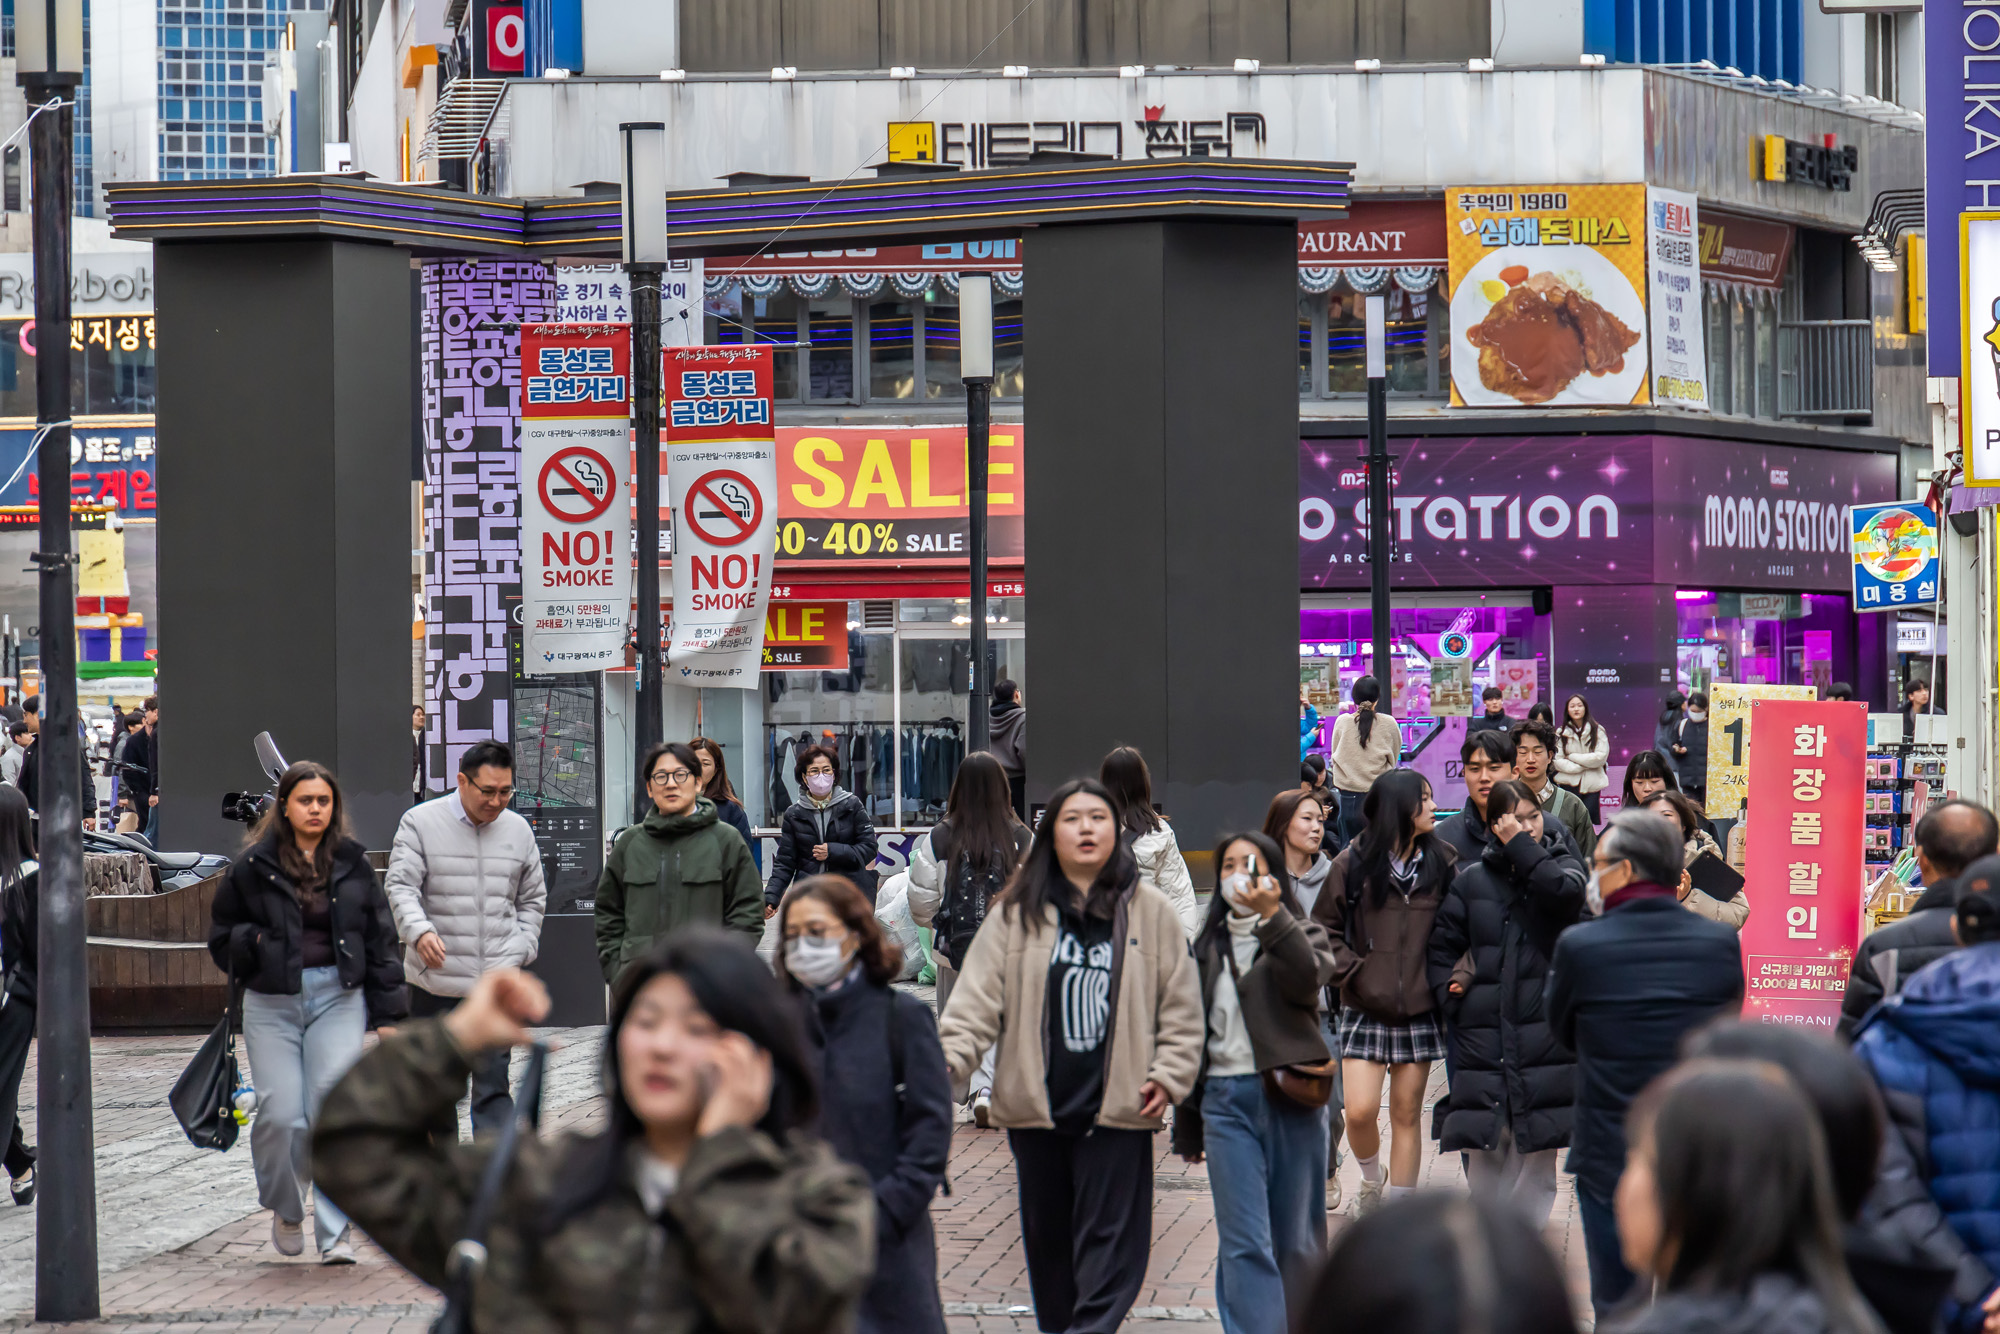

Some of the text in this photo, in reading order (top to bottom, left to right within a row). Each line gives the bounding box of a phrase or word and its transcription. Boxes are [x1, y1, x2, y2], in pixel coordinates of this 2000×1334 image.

[1459, 193, 1567, 212] 추억의 1980
[1478, 216, 1632, 247] 심해돈까스
[575, 283, 603, 300] 경기
[608, 283, 623, 300] 속
[613, 305, 627, 321] 수
[539, 347, 614, 374] 동성로
[527, 375, 626, 404] 금연거리
[681, 370, 757, 398] 동성로
[671, 398, 770, 427] 금연거리
[531, 430, 546, 438] CGV
[676, 453, 691, 462] CGV
[791, 434, 1015, 508] SALE
[1704, 494, 1771, 549] MOMO
[542, 530, 614, 567] NO!
[905, 532, 963, 552] SALE
[542, 569, 614, 587] SMOKE
[691, 553, 761, 591] NO!
[1767, 565, 1794, 576] ARCADE
[1862, 580, 1936, 603] 미용실
[547, 604, 611, 616] 흡연시 5만원의
[691, 592, 757, 611] SMOKE
[536, 617, 620, 629] 과태료가 부과됩니다
[694, 627, 721, 638] 흡연시
[775, 652, 802, 663] SALE
[1588, 668, 1617, 676] MOMO
[1719, 699, 1735, 709] 상위
[1722, 774, 1747, 785] 24K
[1760, 963, 1837, 977] 신규회원 가입시
[1751, 977, 1845, 991] 3,000원 즉시 할인
[1762, 1014, 1832, 1026] ENPRANI
